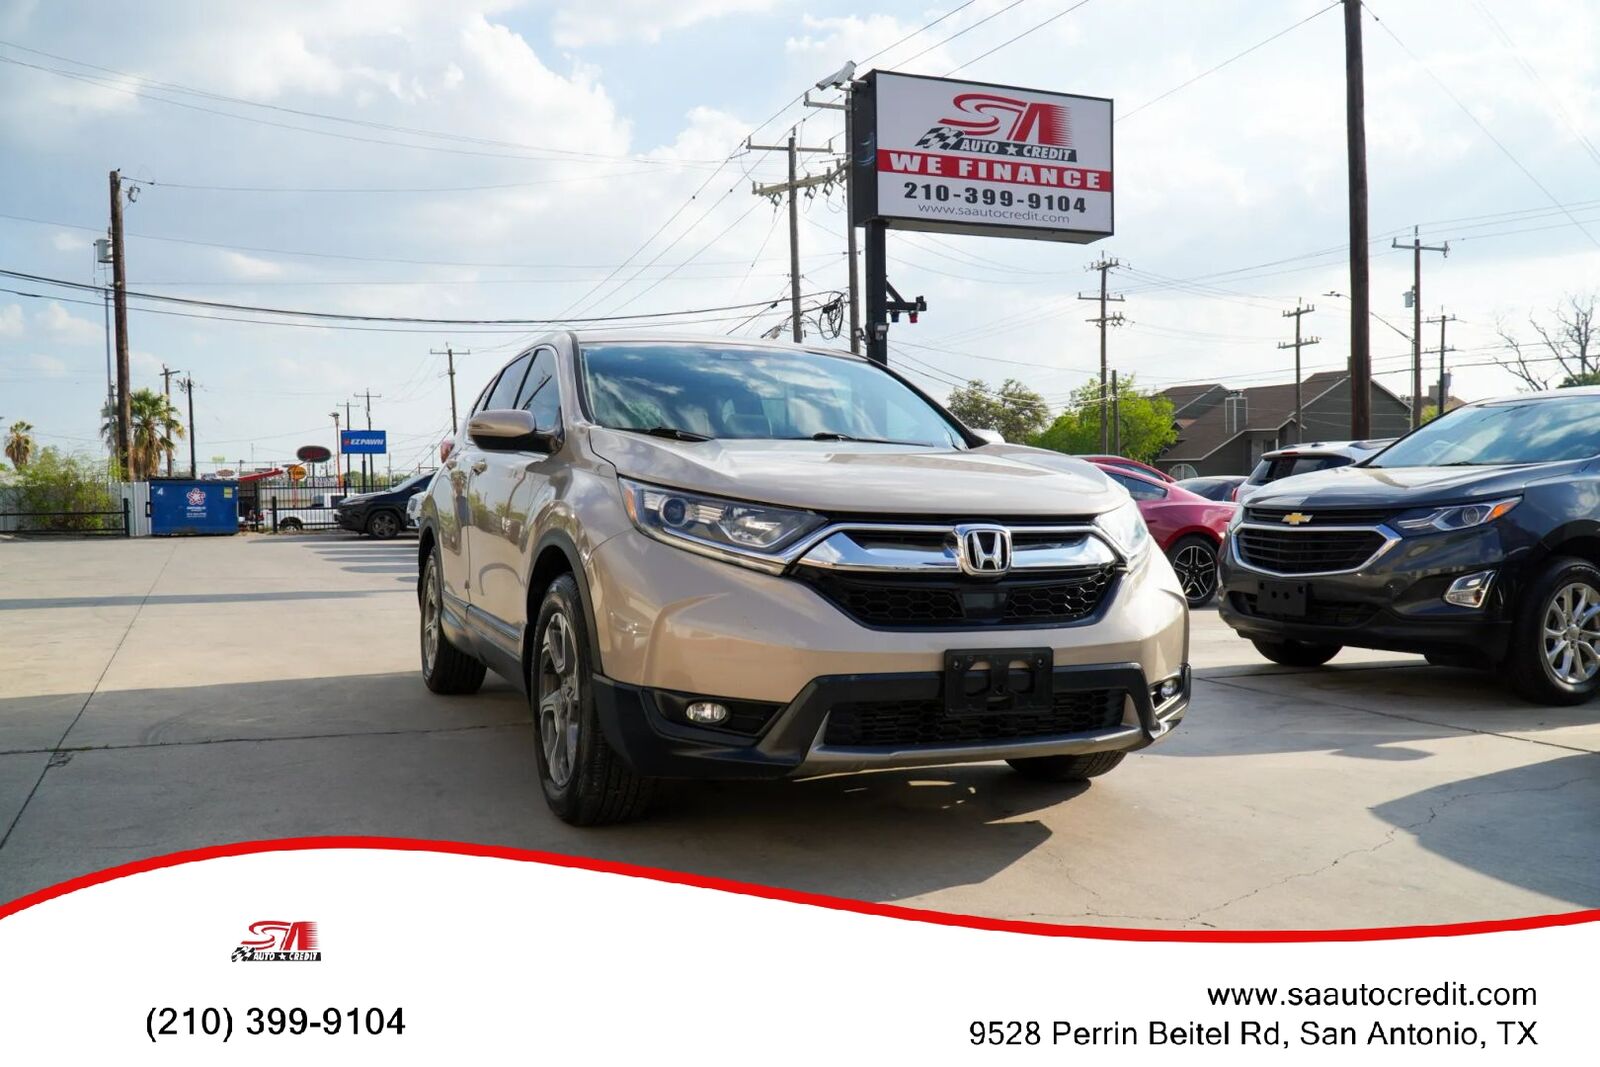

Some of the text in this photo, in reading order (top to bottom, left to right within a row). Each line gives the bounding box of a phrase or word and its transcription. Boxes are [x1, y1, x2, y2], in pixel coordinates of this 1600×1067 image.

[960, 138, 1072, 162] AUTO CREDIT
[890, 152, 1101, 189] WE FINANCE
[904, 181, 1087, 213] 210-399-9104
[918, 203, 1071, 224] www.saautocredit.com
